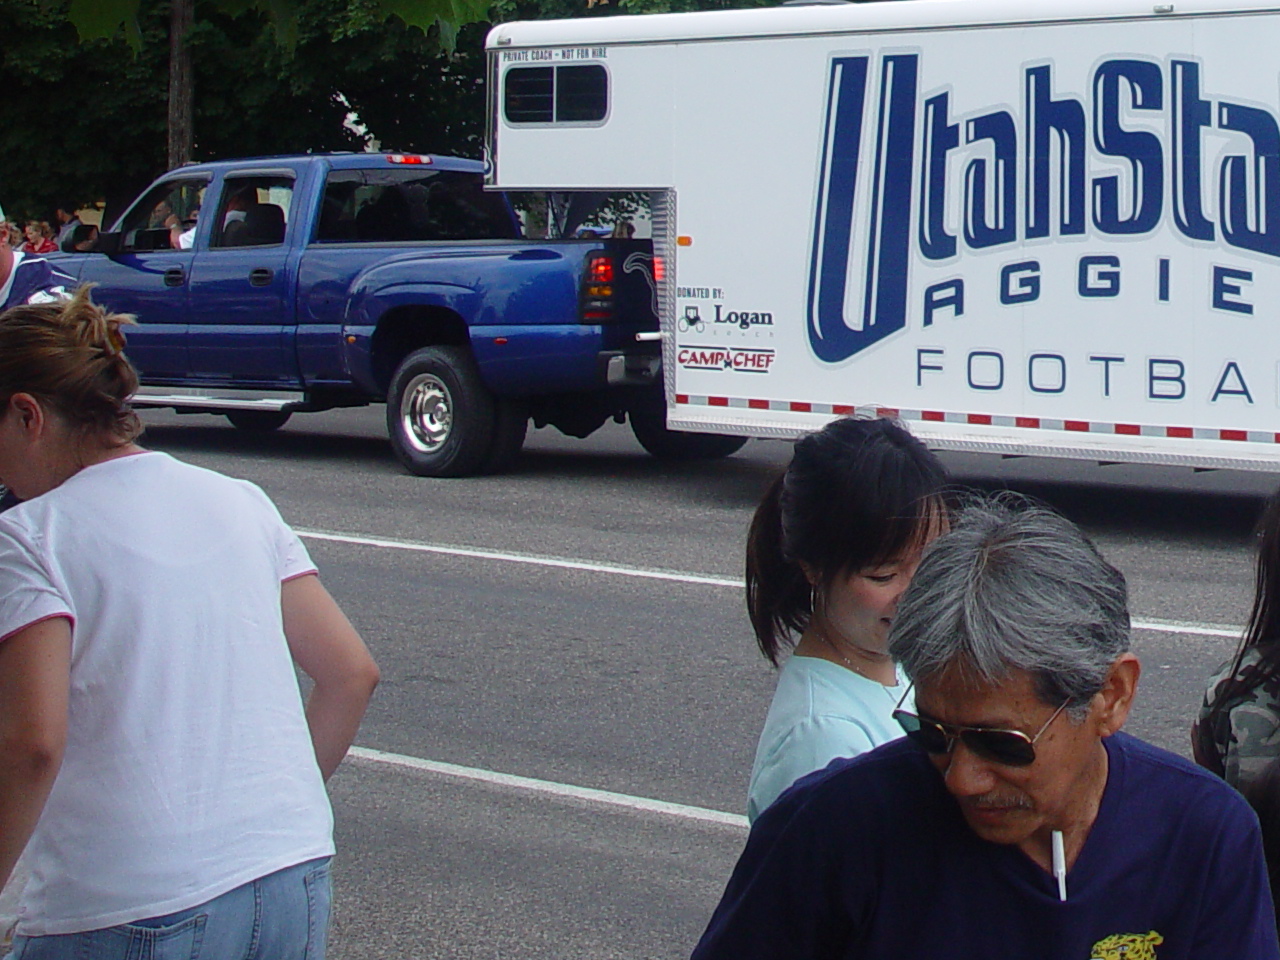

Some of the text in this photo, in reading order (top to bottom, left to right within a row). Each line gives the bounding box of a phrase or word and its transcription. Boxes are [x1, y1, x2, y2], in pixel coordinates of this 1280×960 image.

[531, 49, 553, 60] COACH
[561, 49, 574, 59] NOT
[577, 48, 589, 58] FOR
[677, 287, 724, 299] DONATED BY:
[714, 304, 774, 329] Logan
[678, 349, 775, 368] CAMP CHEF
